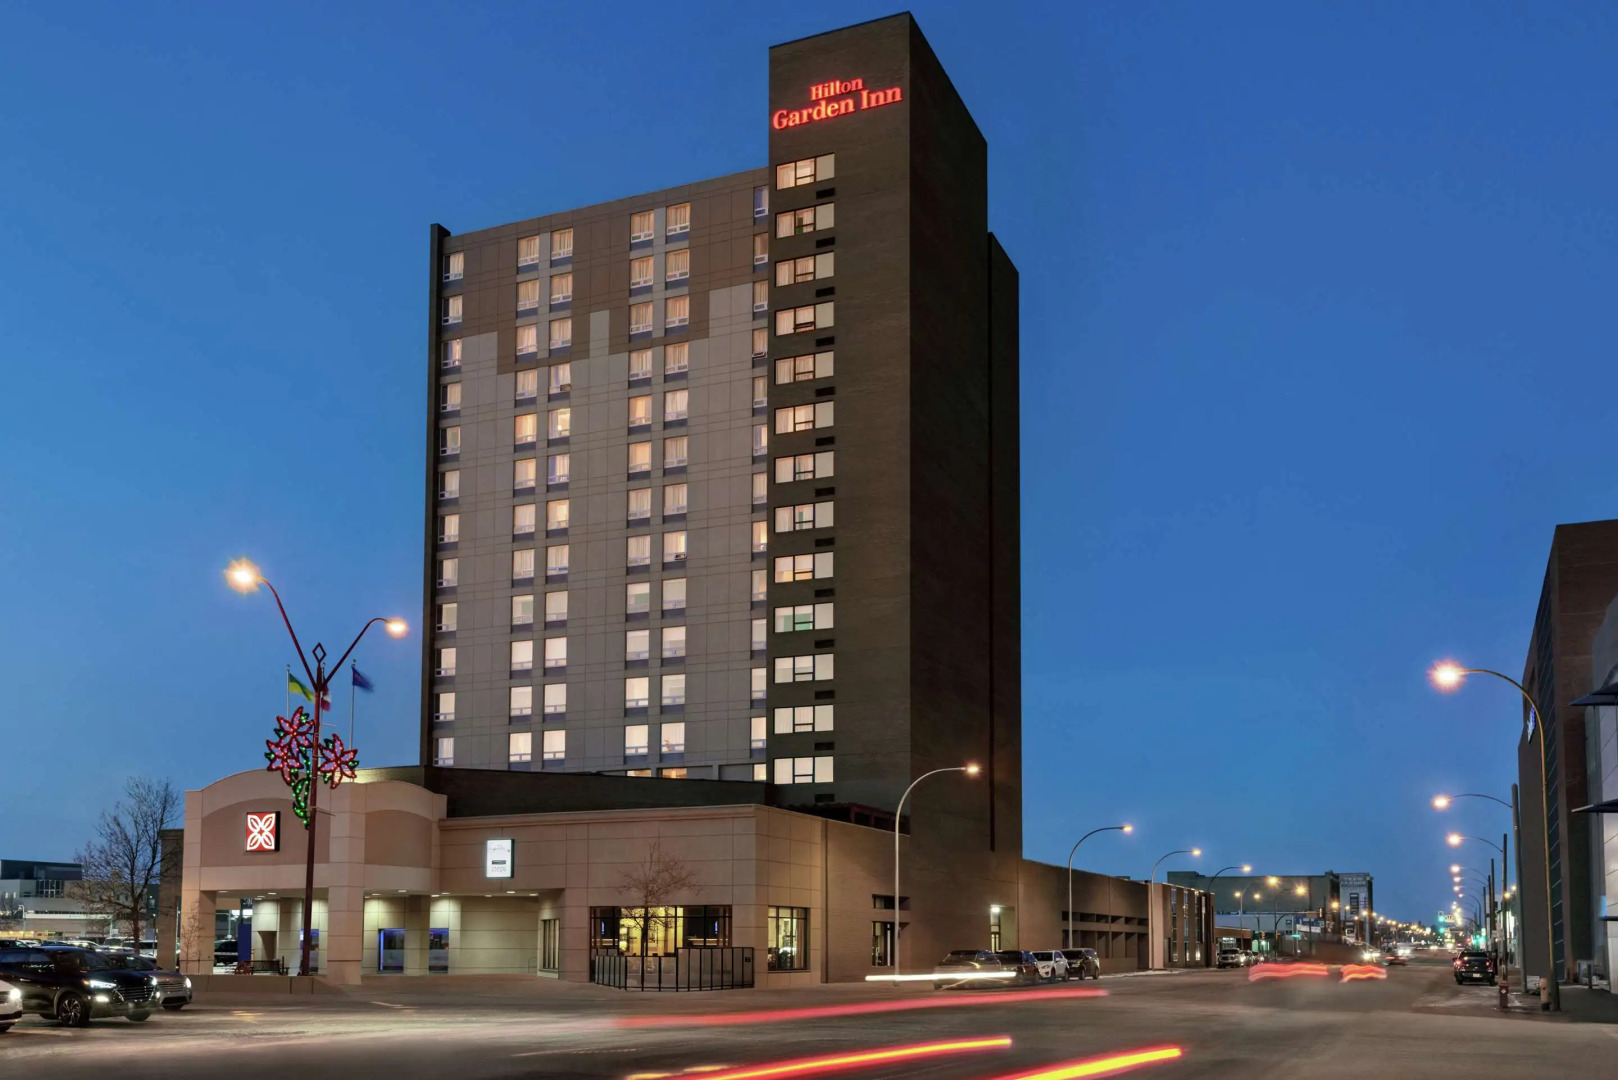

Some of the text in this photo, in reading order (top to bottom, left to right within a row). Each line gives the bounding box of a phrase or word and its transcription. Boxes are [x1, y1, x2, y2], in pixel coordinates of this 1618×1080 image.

[810, 78, 863, 100] Hilton
[773, 87, 902, 130] Garden Inn
